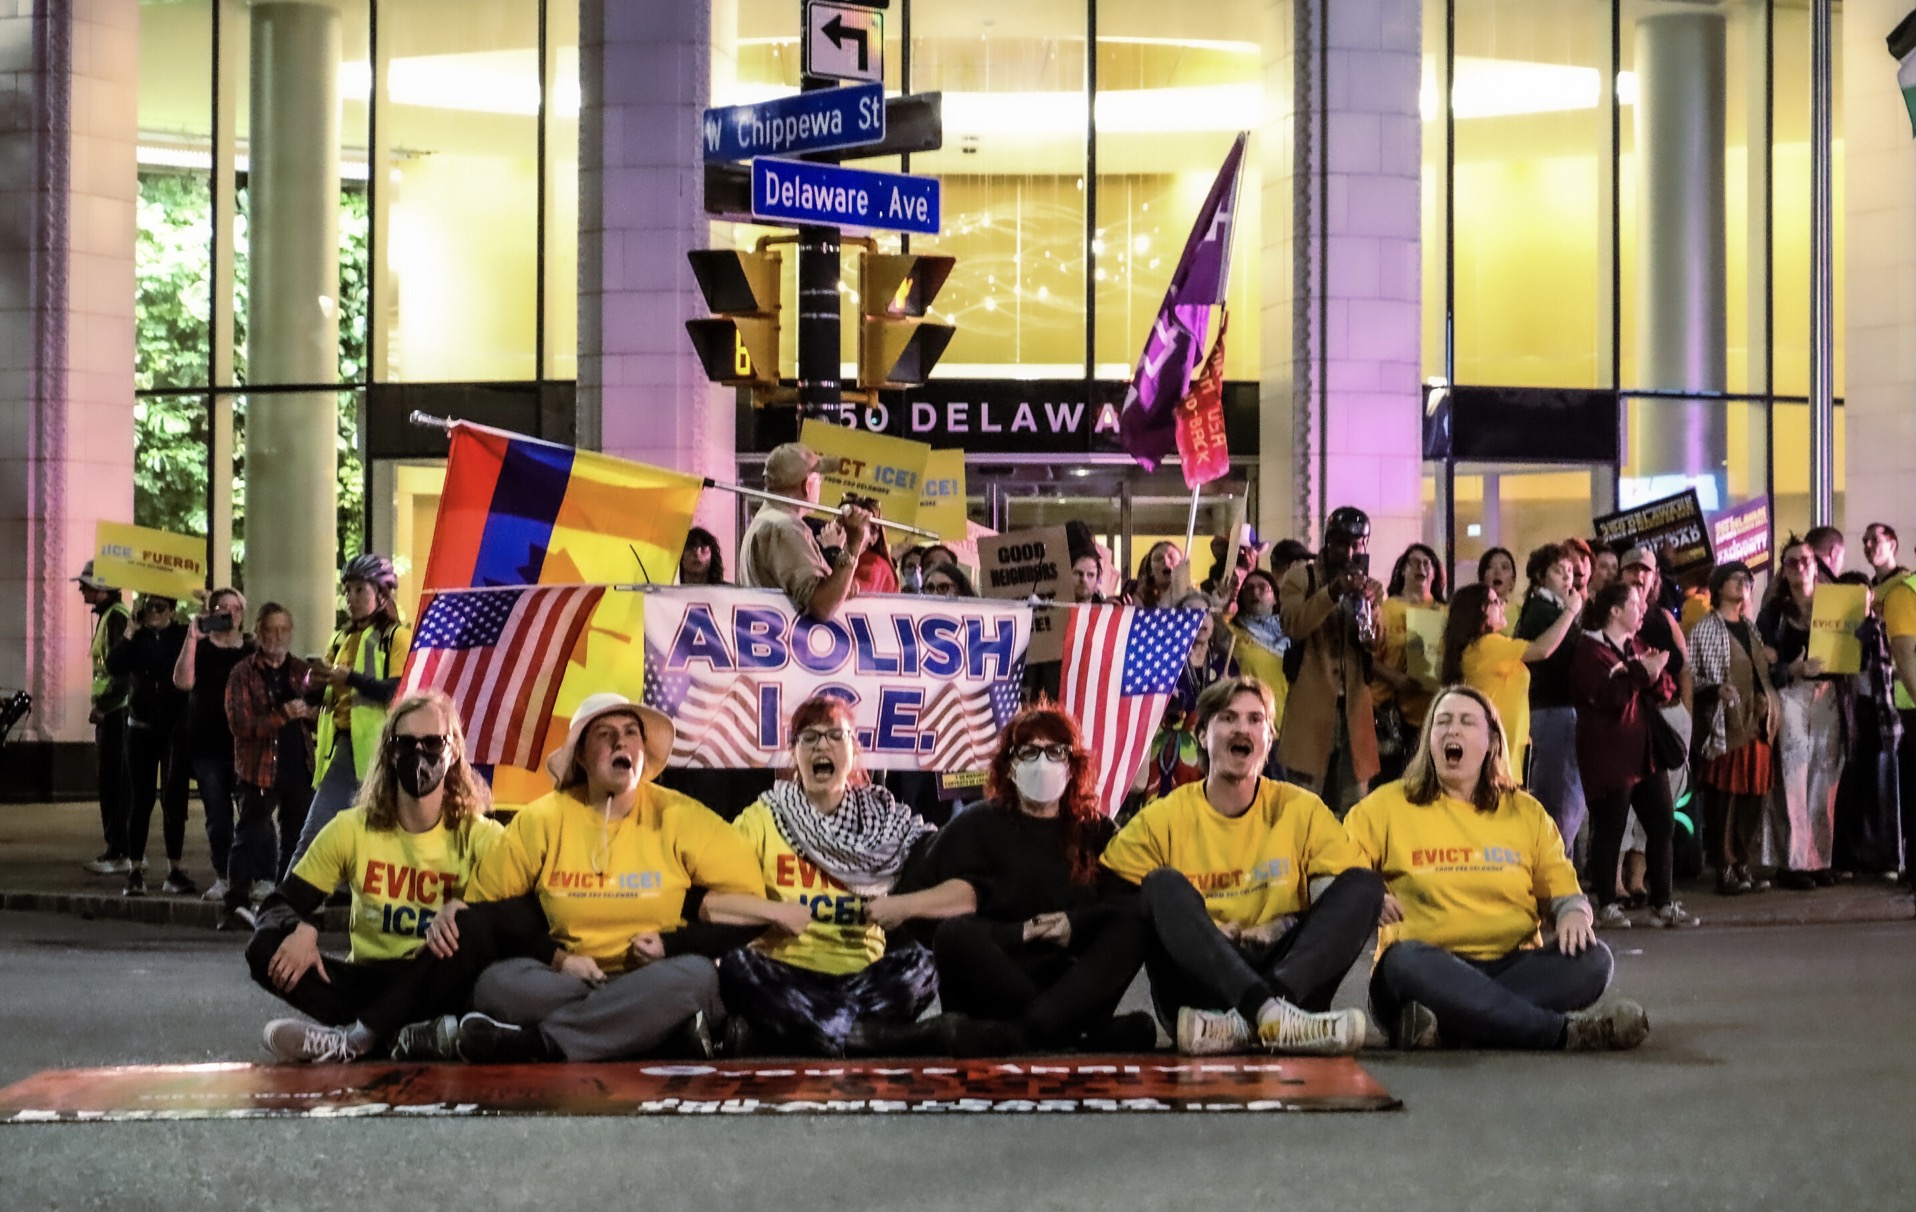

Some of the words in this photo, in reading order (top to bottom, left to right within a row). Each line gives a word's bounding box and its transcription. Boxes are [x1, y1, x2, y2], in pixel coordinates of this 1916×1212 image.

[704, 117, 722, 151] W
[737, 109, 842, 149] Chippewa
[858, 95, 881, 130] St
[765, 169, 869, 216] Delaware
[888, 186, 928, 222] Ave
[840, 402, 889, 433] 50
[912, 402, 1121, 433] DELAWA
[1206, 406, 1227, 448] USA
[874, 464, 917, 490] ICE!
[142, 549, 200, 574] FUERA!
[997, 541, 1046, 564] GOOD
[664, 602, 1017, 681] ABOLISH
[757, 682, 938, 755] I..E.
[1411, 848, 1473, 867] EVICT
[362, 859, 460, 905] EVICT
[547, 870, 610, 889] EVICT
[619, 870, 662, 889] ICE!
